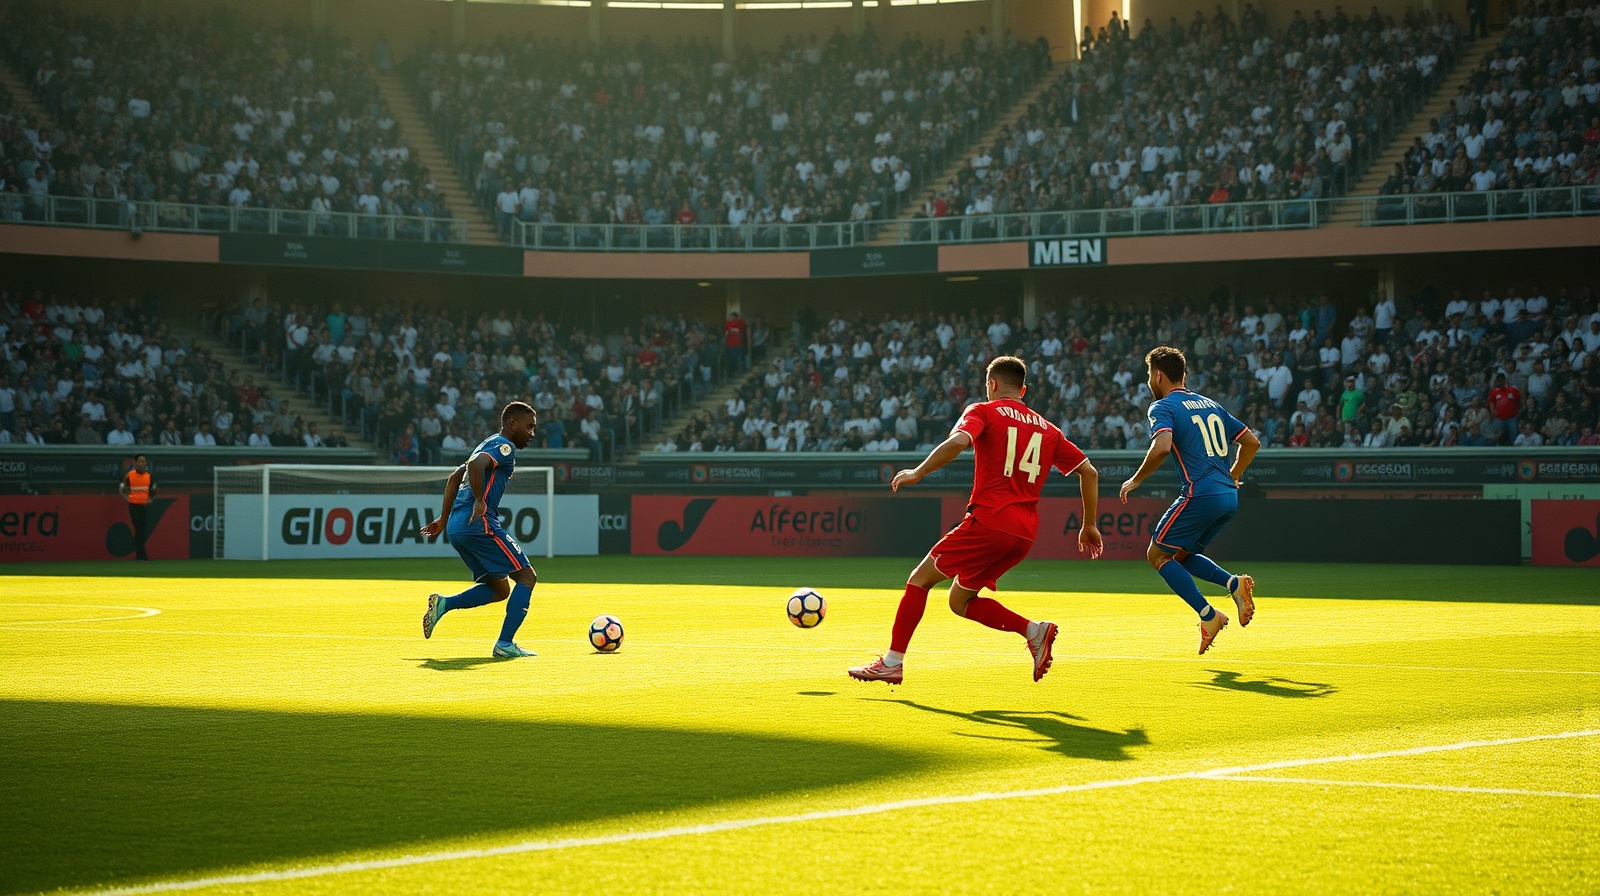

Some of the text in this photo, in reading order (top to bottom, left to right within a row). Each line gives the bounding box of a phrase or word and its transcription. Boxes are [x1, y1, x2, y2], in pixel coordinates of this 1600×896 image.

[1034, 239, 1101, 265] MEN
[1003, 426, 1043, 484] 14
[1191, 413, 1228, 457] 10
